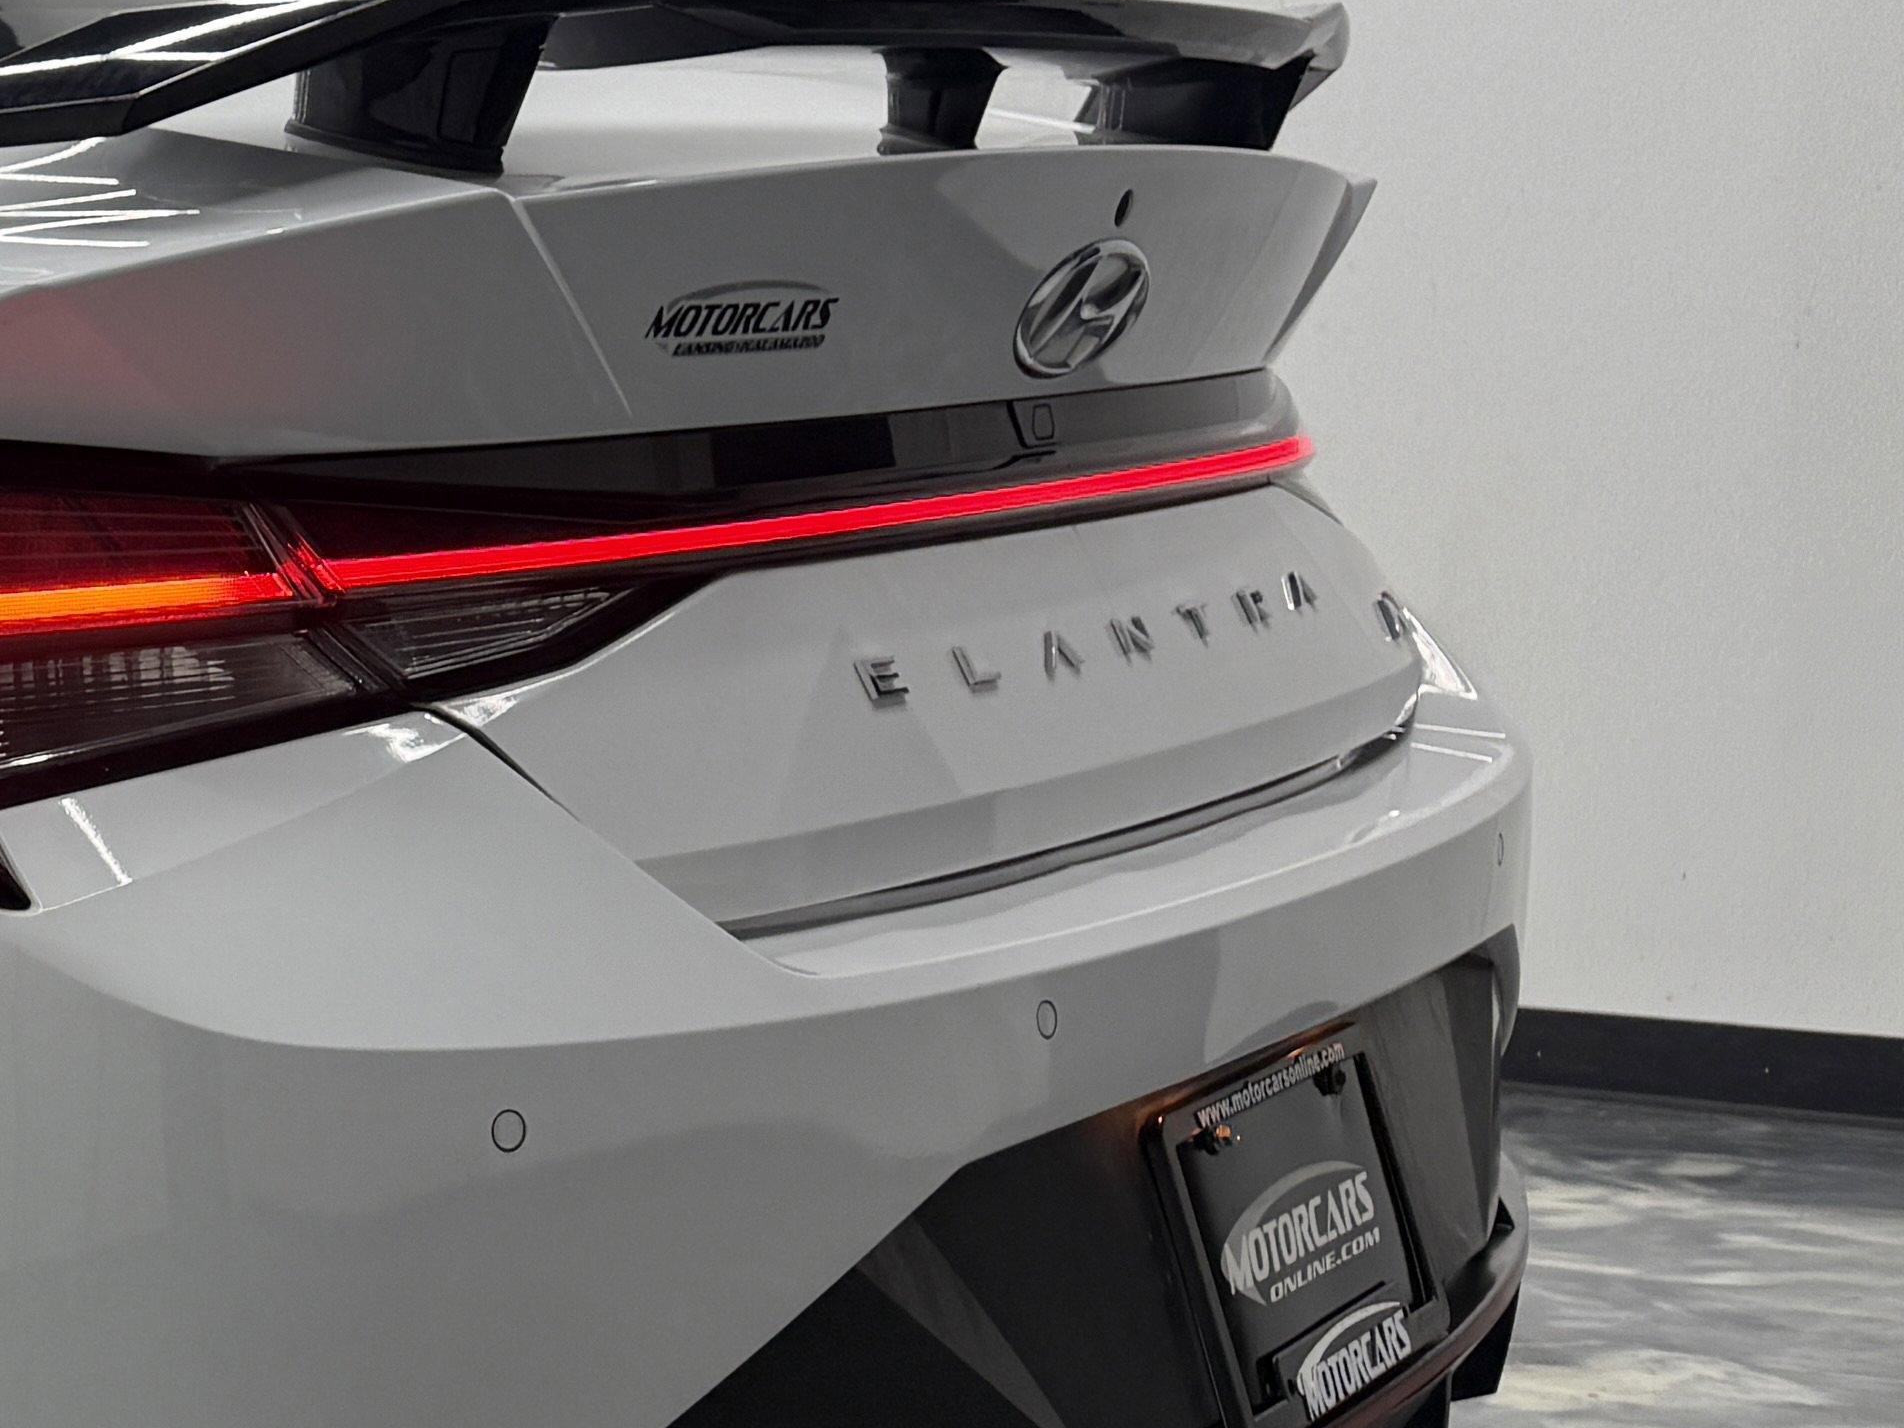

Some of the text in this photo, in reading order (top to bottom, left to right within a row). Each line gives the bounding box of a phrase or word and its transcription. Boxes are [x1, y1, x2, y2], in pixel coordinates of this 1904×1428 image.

[645, 298, 840, 340] MOTORCARS
[854, 571, 1318, 705] ELANTRA
[1197, 1042, 1345, 1128] www.motorcarsonline.com
[1225, 1171, 1375, 1296] MOTORCARS
[1269, 1227, 1381, 1304] ONLINE.COM
[1299, 1310, 1412, 1422] MOTORCARS
